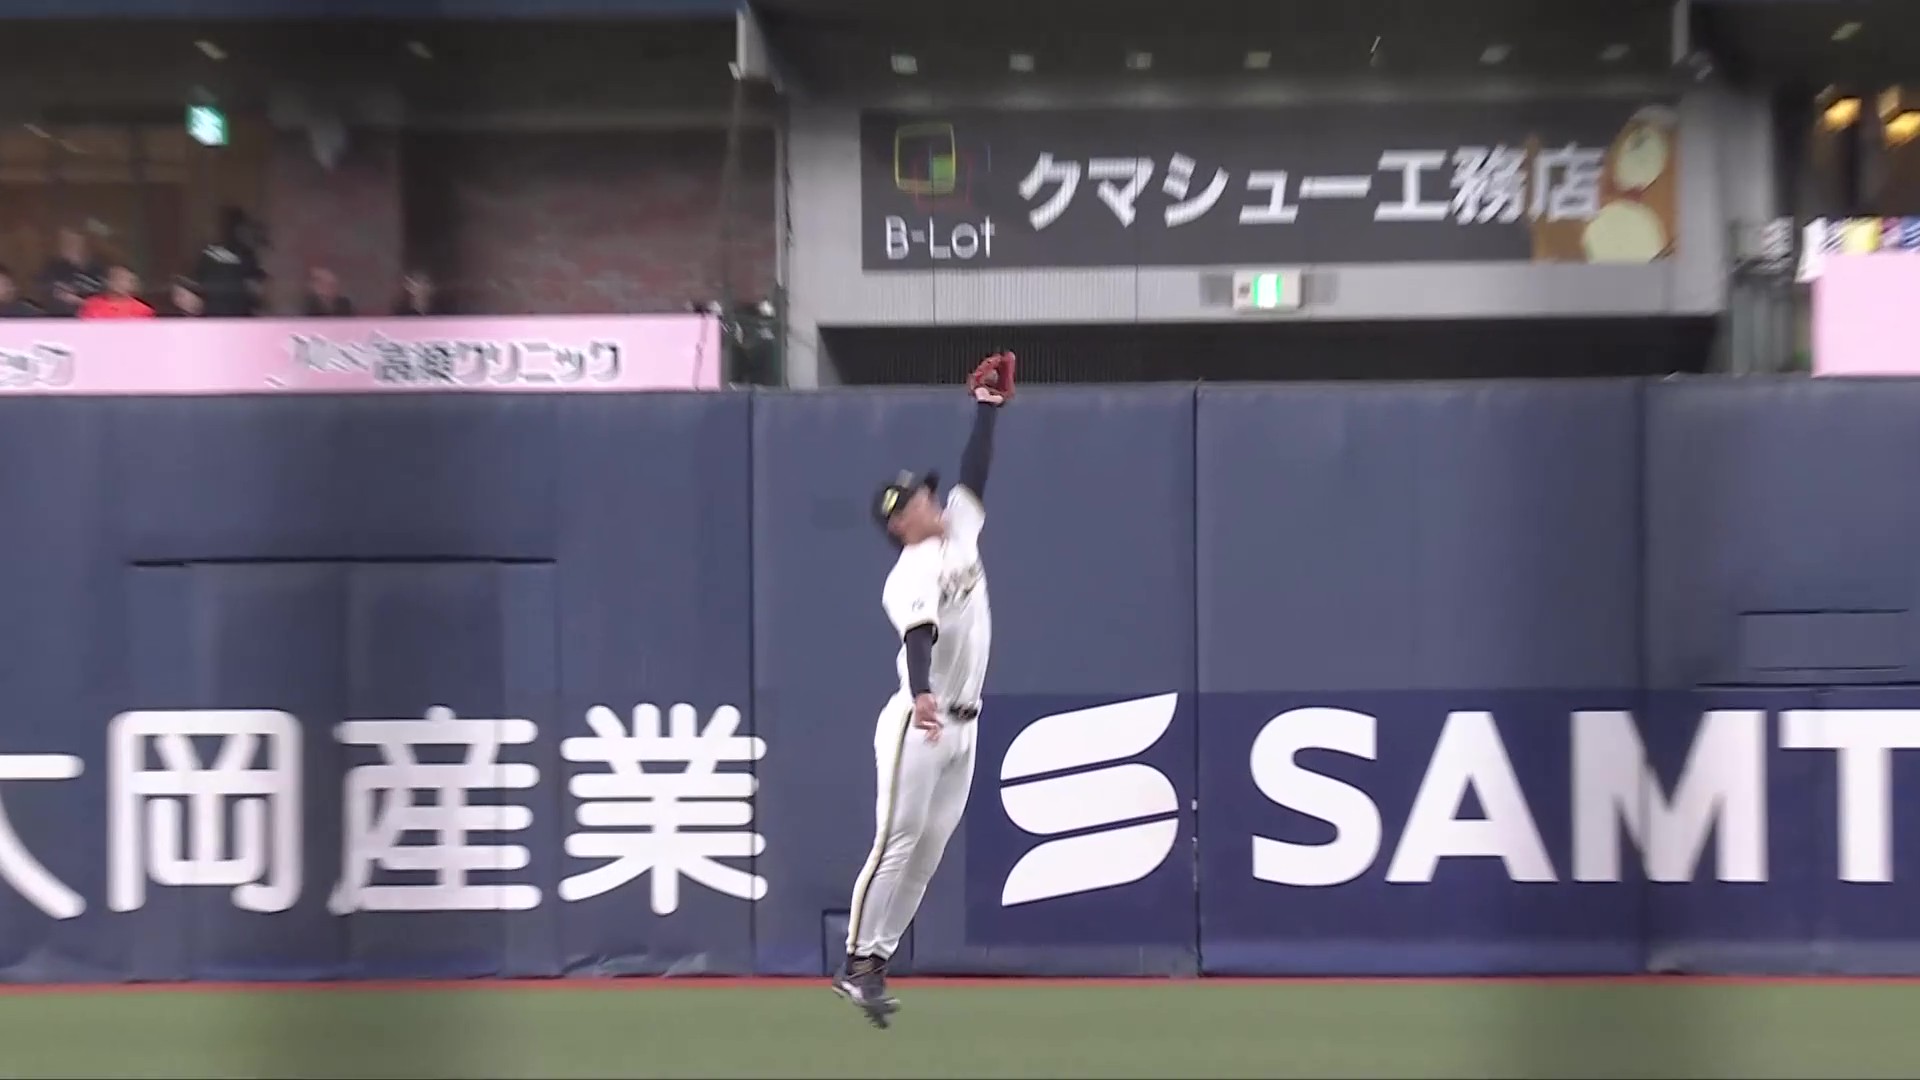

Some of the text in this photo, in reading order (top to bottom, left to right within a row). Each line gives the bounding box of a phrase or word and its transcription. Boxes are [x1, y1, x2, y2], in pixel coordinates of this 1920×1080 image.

[1018, 143, 1603, 231] クマシュー工務店
[885, 215, 996, 260] B-Lot
[1250, 707, 1920, 886] SAMT
